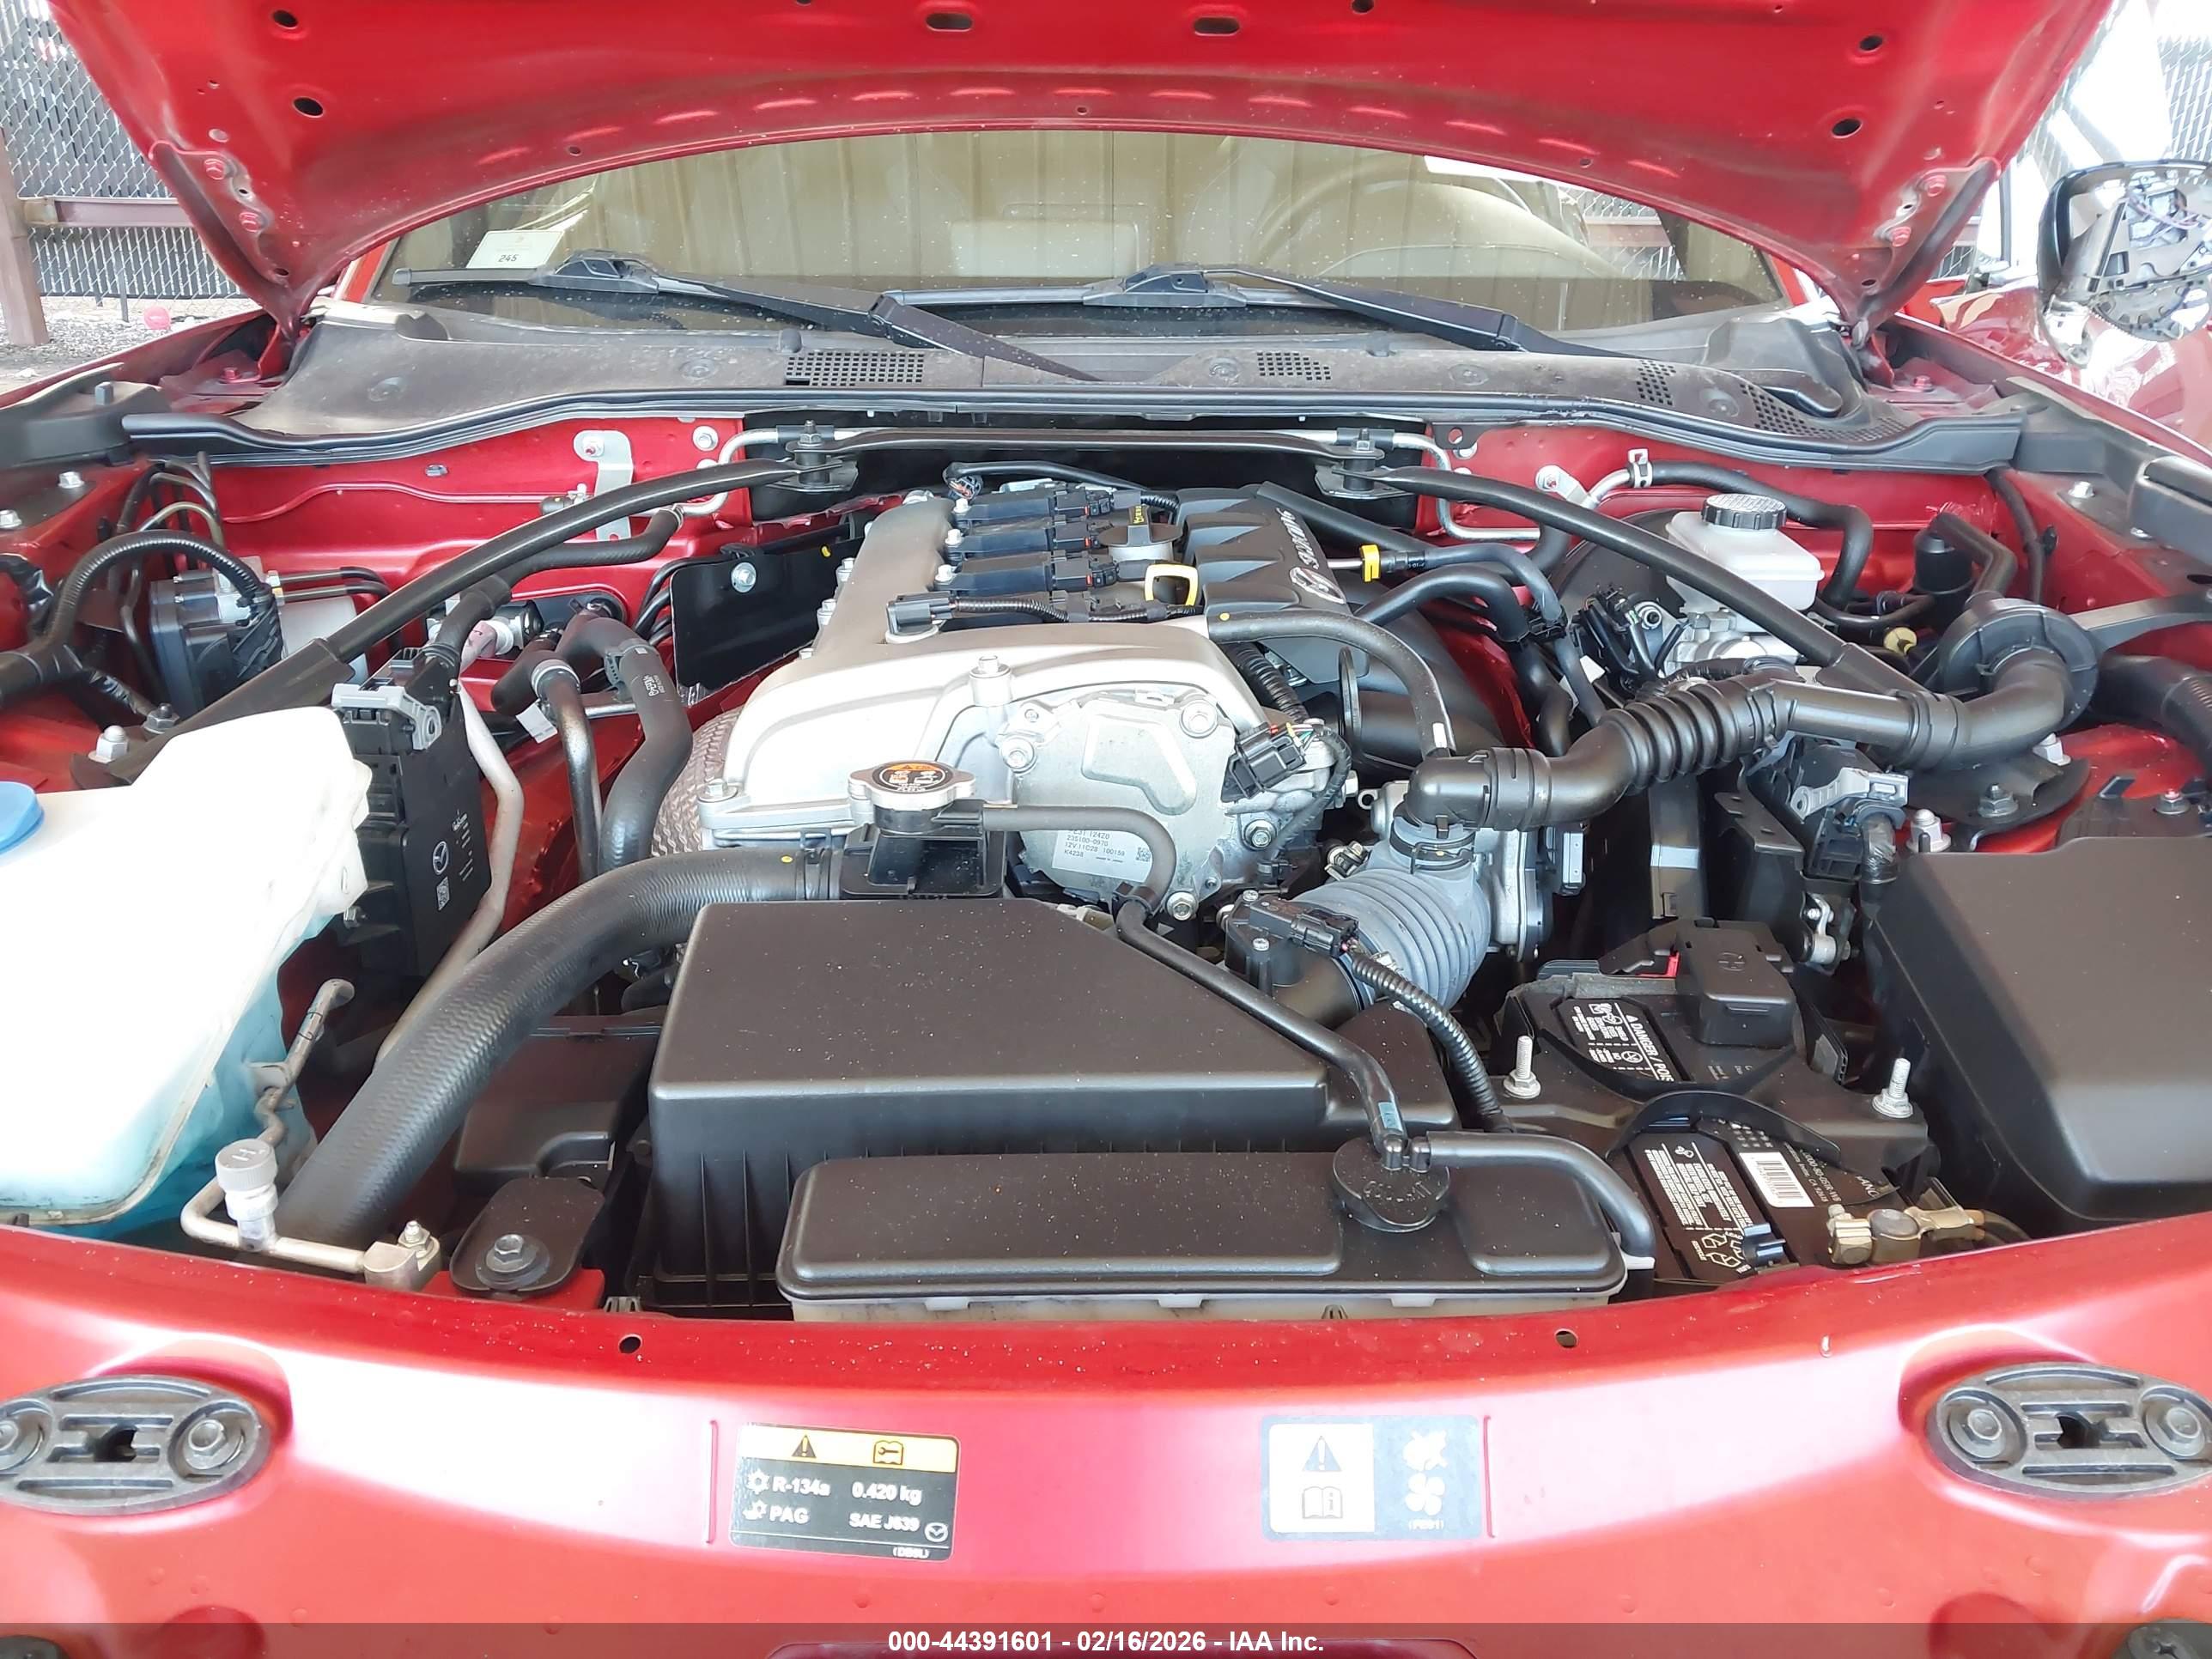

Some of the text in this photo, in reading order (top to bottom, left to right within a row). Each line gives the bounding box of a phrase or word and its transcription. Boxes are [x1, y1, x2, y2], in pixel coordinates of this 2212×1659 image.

[1630, 1023, 1659, 1056] DANGER
[772, 1475, 831, 1497] R-134a
[851, 1482, 923, 1507] 0.420 kg
[769, 1506, 811, 1525] PAG
[848, 1512, 883, 1529] SAE
